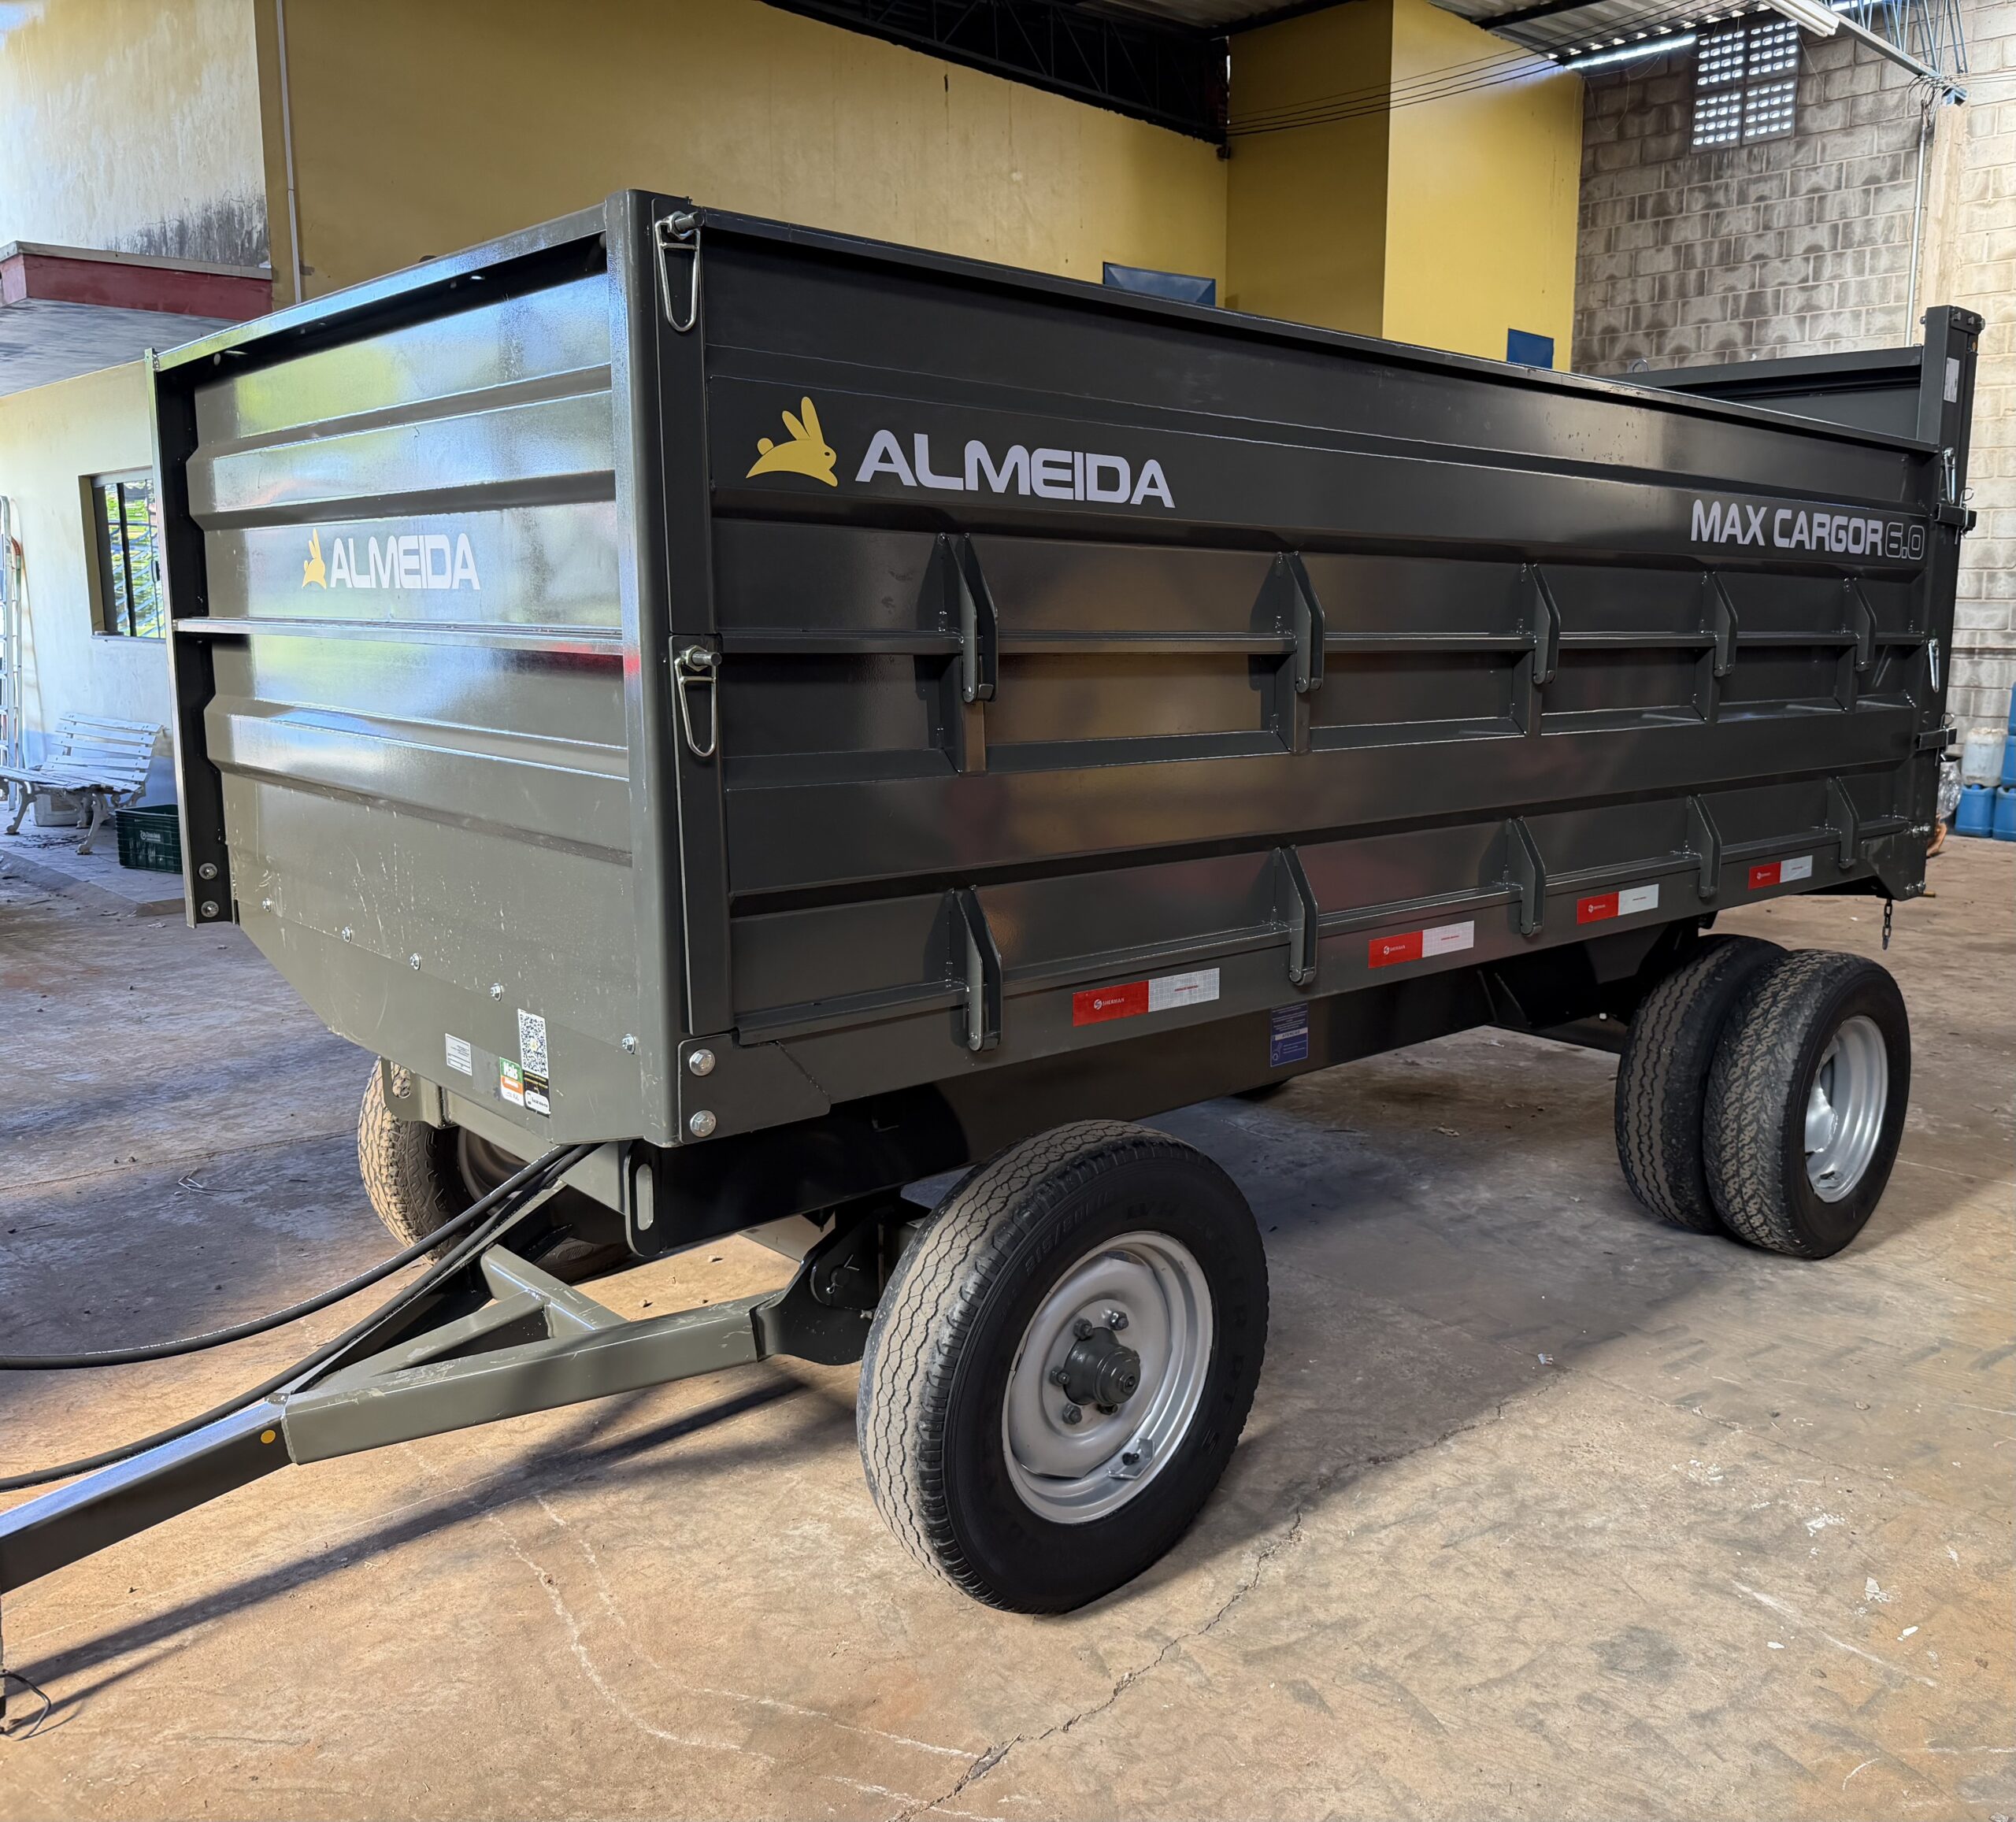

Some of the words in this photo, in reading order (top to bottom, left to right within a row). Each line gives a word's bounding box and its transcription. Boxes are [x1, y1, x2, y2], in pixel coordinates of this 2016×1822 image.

[855, 429, 1176, 509] ALMEIDA
[1691, 499, 1767, 546] MAX
[1773, 509, 1883, 556] CARGOR
[1885, 522, 1925, 561] 6.0
[330, 533, 481, 591] ALMEIDA
[1102, 998, 1125, 1006] SHERMAN
